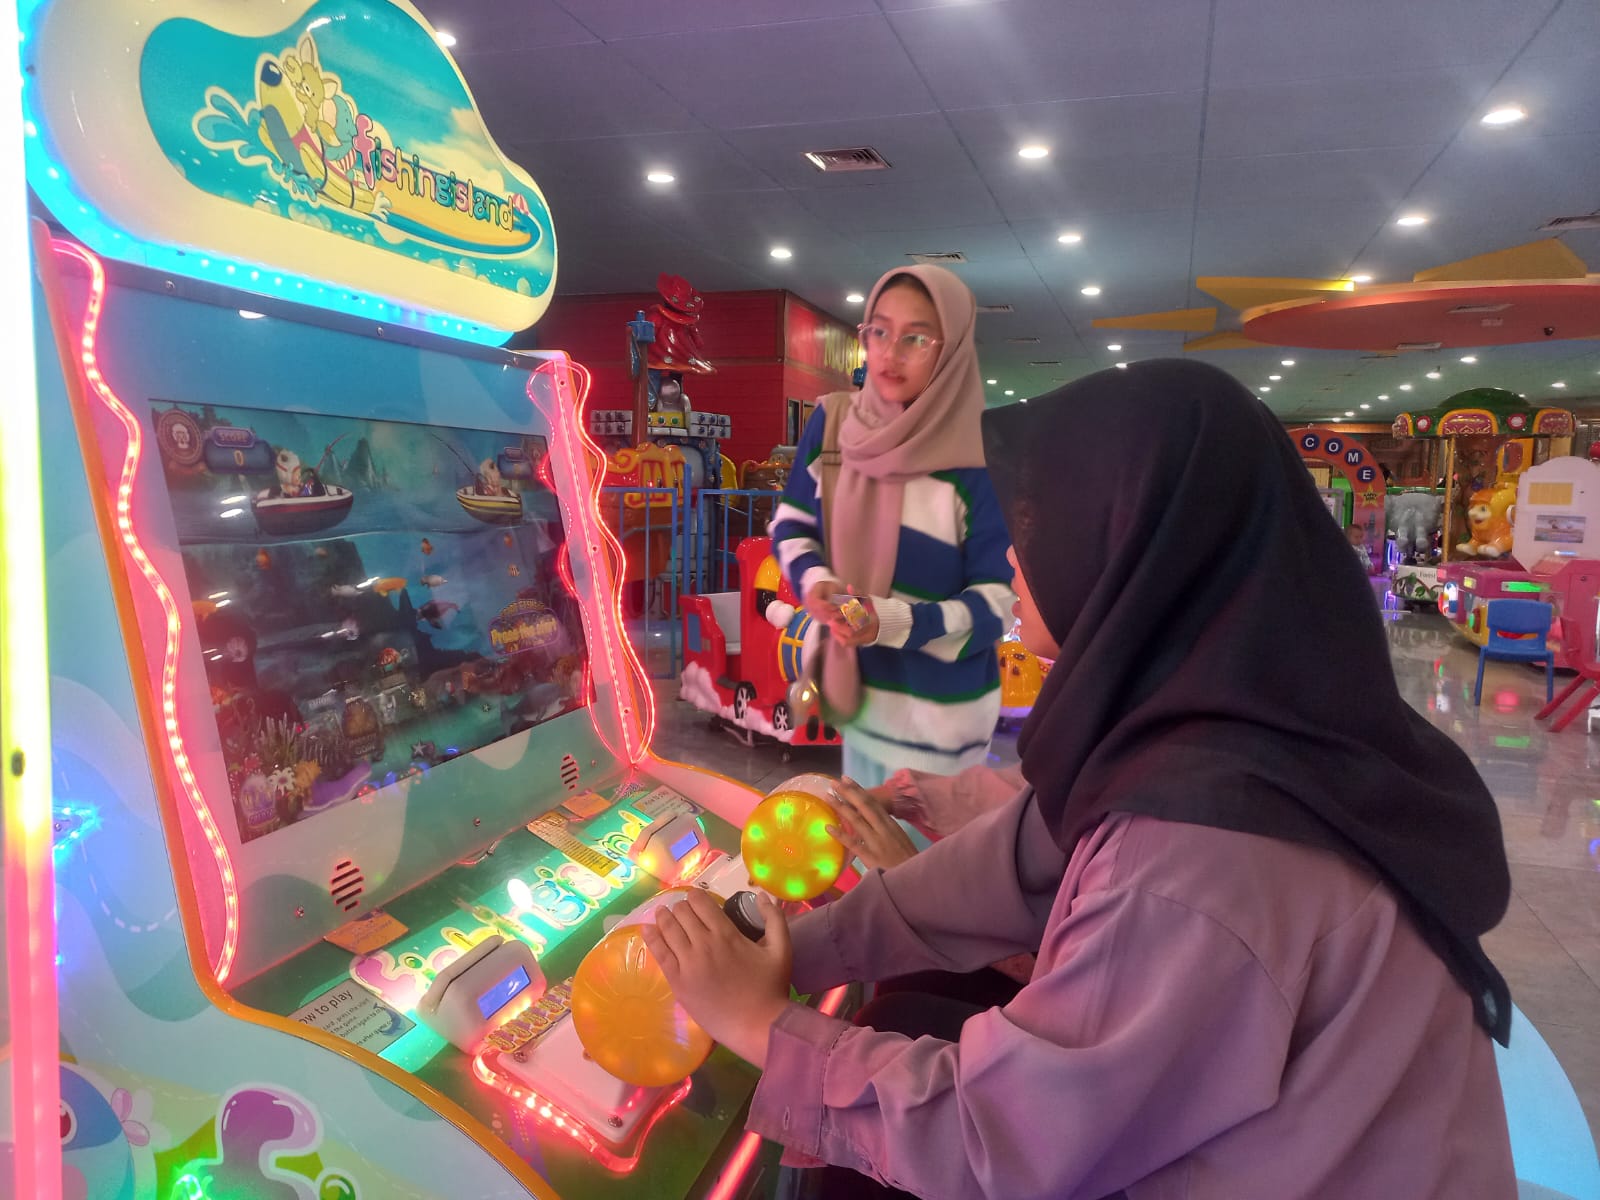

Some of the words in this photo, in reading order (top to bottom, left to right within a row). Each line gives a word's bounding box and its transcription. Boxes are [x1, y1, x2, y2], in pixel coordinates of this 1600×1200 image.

[352, 113, 513, 232] fishingisland
[1305, 437, 1371, 480] COME
[315, 1005, 330, 1015] to
[329, 989, 353, 1009] play
